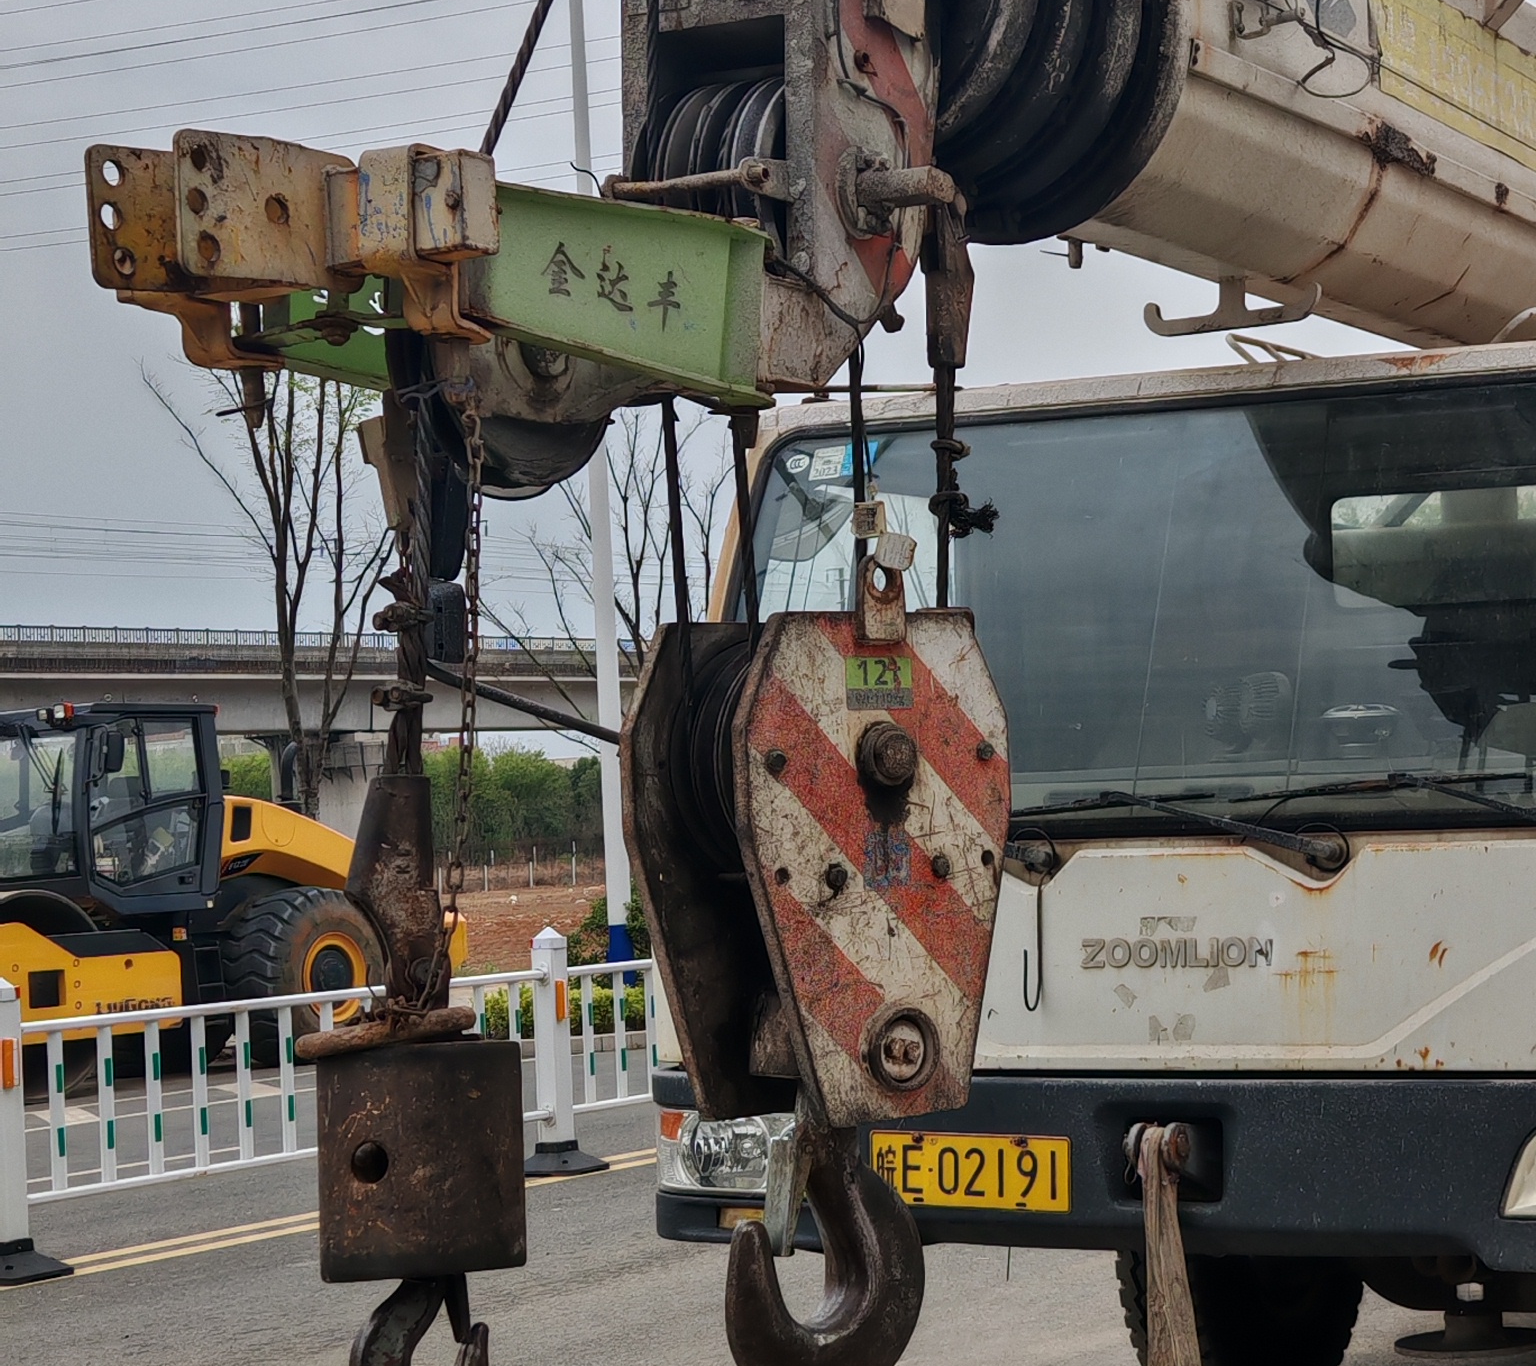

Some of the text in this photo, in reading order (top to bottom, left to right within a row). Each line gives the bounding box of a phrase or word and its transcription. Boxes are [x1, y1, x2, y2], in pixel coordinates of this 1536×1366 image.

[541, 241, 681, 332] 金达丰
[1080, 937, 1274, 969] ZOOMLION
